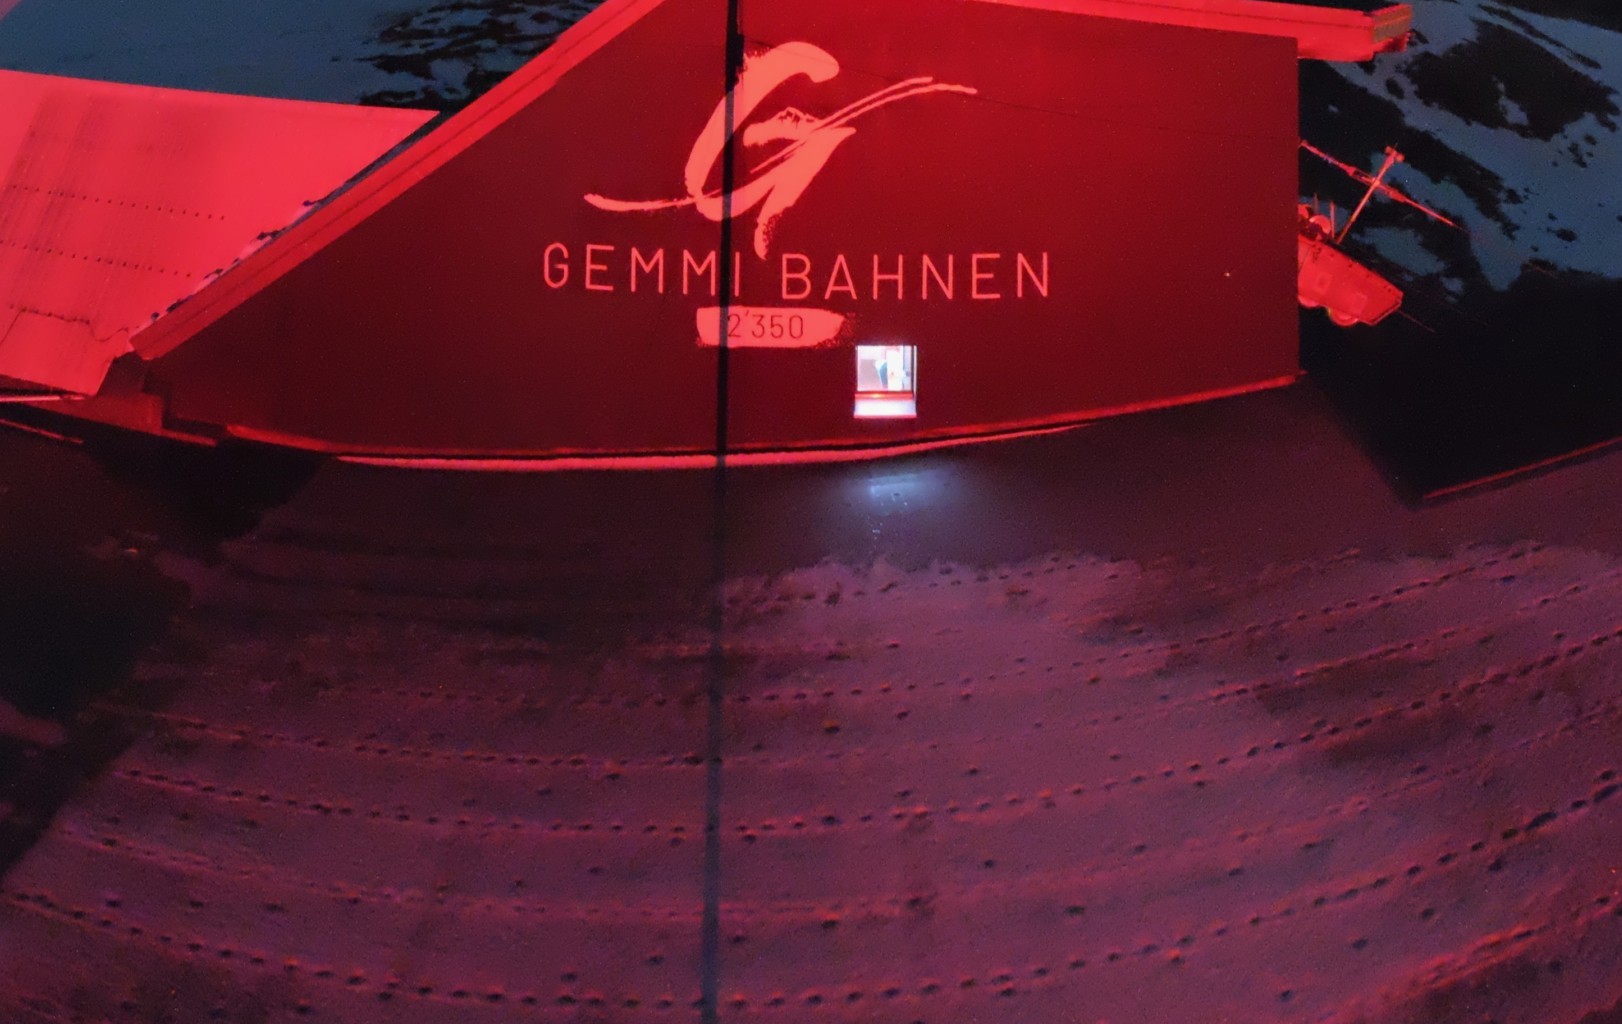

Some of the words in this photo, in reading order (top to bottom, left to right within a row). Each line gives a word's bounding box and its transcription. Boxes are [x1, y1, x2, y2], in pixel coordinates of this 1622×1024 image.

[542, 242, 742, 298] GEMMI
[781, 251, 1049, 301] BAHNEN
[726, 309, 805, 340] 2'350
